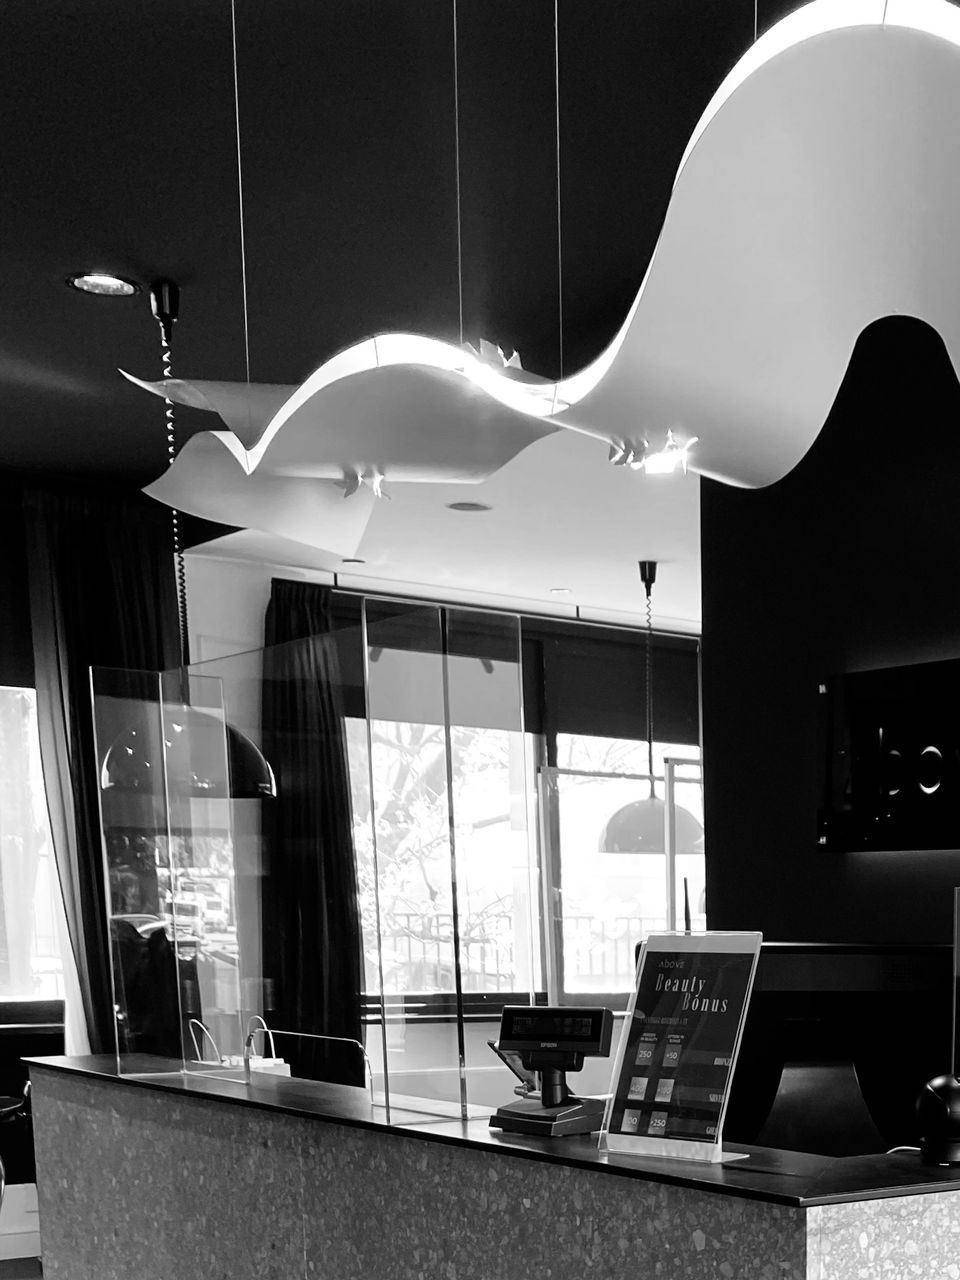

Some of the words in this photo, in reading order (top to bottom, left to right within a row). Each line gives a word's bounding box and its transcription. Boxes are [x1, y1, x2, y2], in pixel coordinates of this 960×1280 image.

[655, 974, 707, 997] Beauty
[682, 992, 729, 1013] Bonus
[638, 1050, 652, 1058] 250
